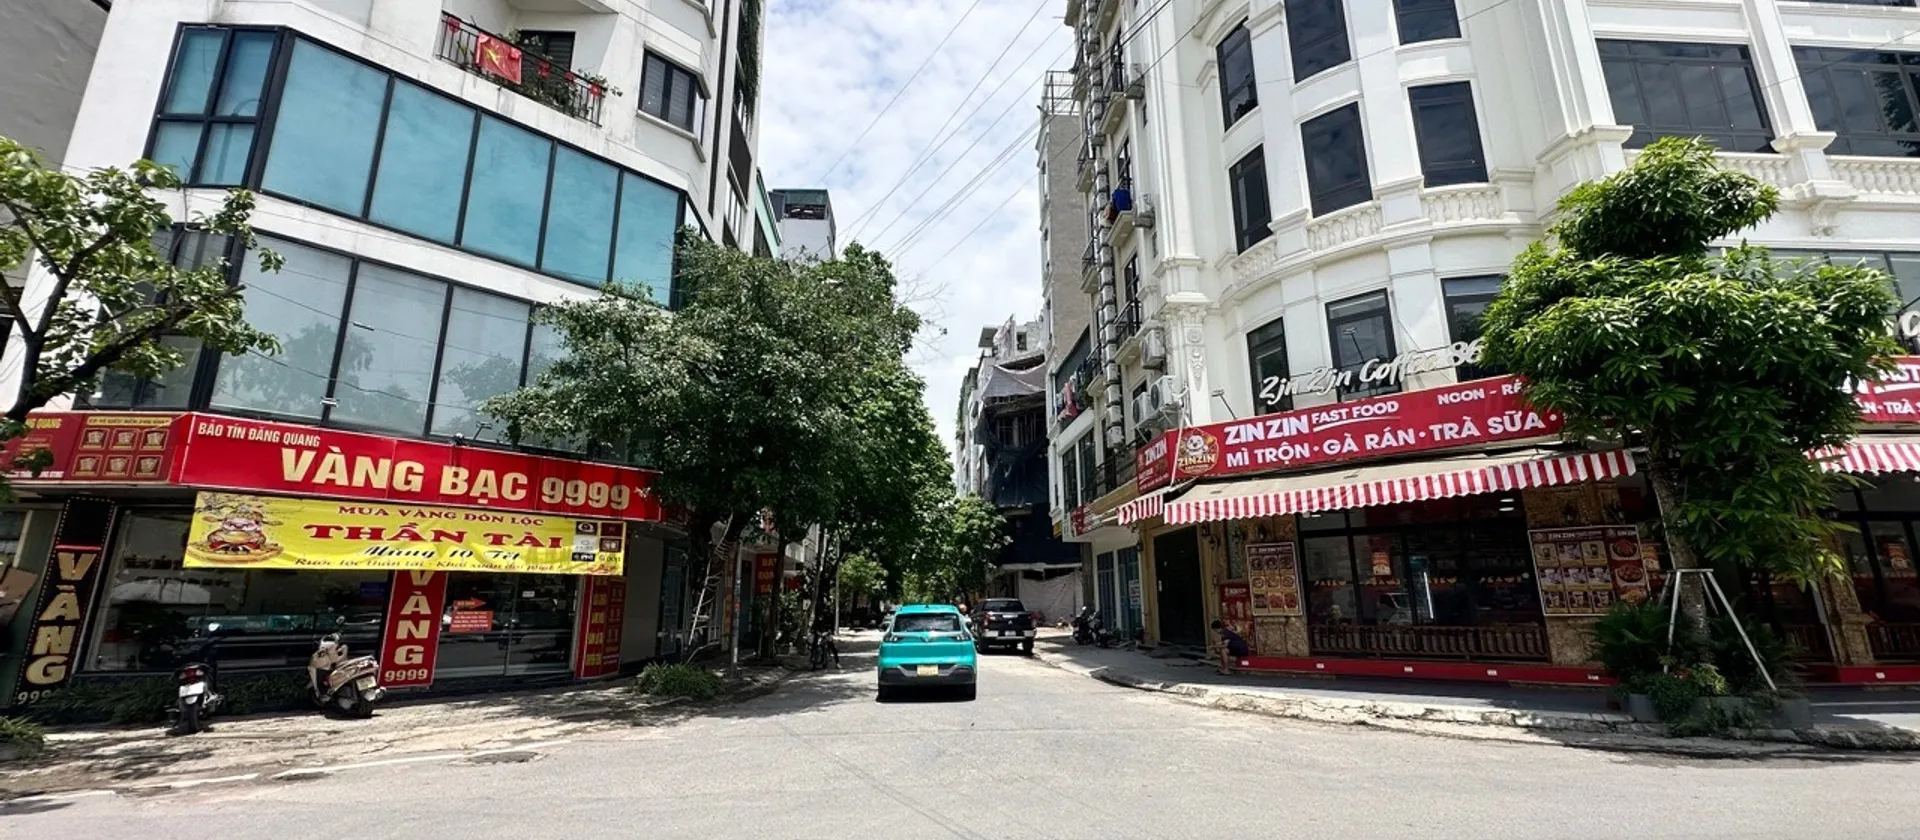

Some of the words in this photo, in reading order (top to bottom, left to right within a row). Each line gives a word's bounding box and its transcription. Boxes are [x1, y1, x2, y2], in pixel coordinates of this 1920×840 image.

[1359, 350, 1439, 385] Coffee
[1437, 388, 1485, 405] NGON
[1883, 398, 1916, 414] TRÀ
[1312, 407, 1350, 424] FAST
[1352, 400, 1399, 418] FOOD
[198, 419, 223, 437] BẢO
[227, 423, 246, 439] TÍN
[283, 432, 321, 447] QUANG
[1226, 443, 1250, 468] MÌ
[1254, 441, 1311, 465] TRỘN
[1323, 432, 1359, 455] GÀ
[1364, 427, 1416, 450] RÁN
[1428, 415, 1482, 441] TRÀ
[1487, 410, 1546, 435] SỮA
[281, 445, 425, 493] VÀNG
[439, 464, 528, 505] BẠC
[541, 477, 630, 510] 9999
[338, 505, 389, 516] MUA
[398, 508, 457, 520] VÀNG
[463, 511, 504, 523] ĐÓN
[510, 516, 544, 527] LỘC
[303, 521, 467, 544] THẦN
[483, 532, 563, 549] TÀI
[449, 550, 474, 559] 10
[26, 552, 97, 685] VÀNG
[394, 571, 434, 665] VÀNG
[384, 669, 428, 682] 9999
